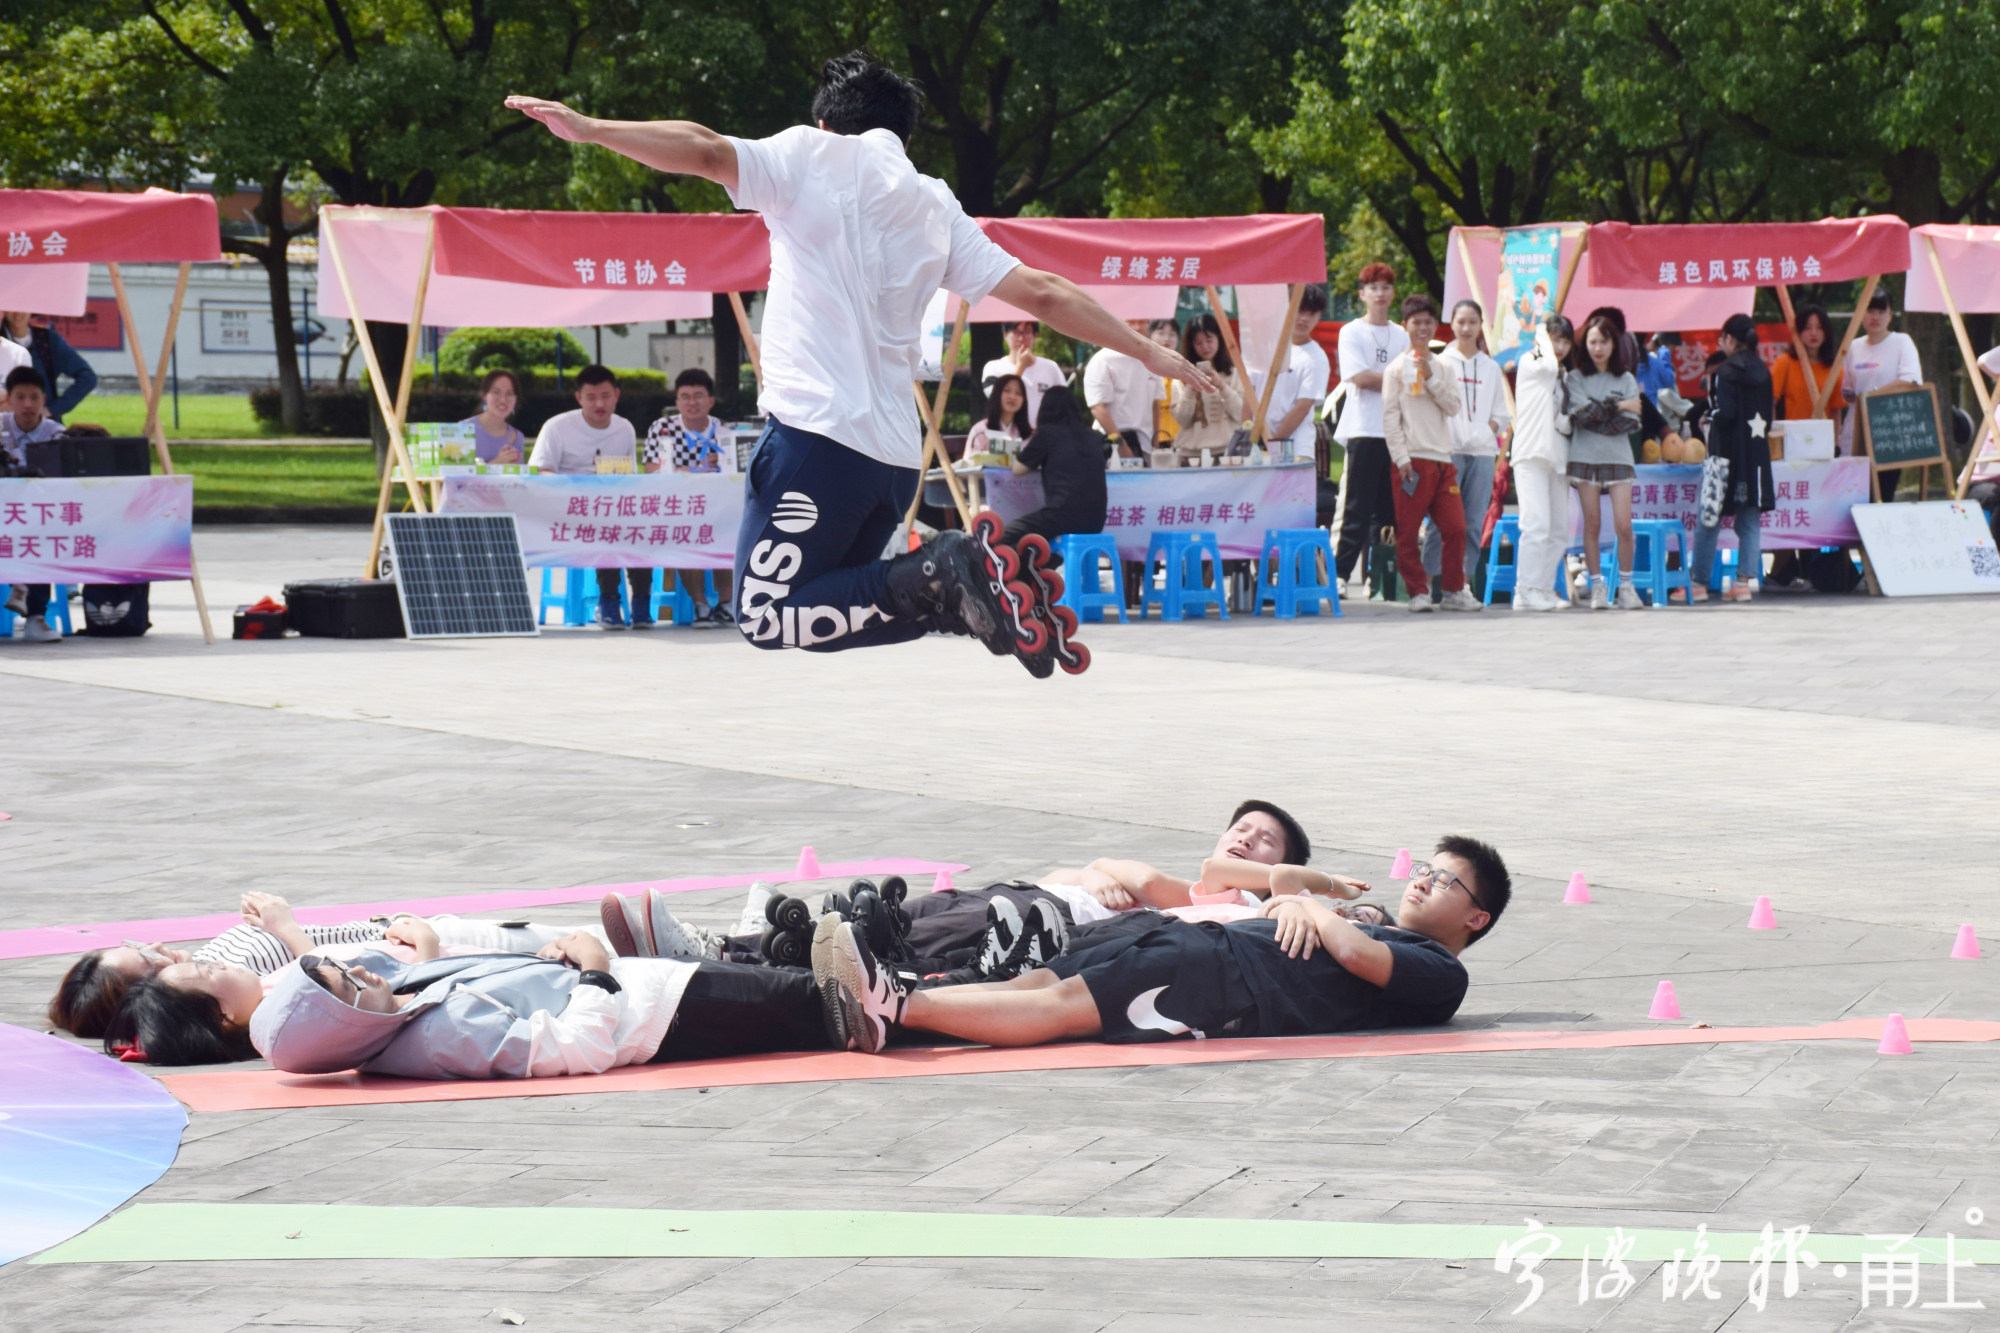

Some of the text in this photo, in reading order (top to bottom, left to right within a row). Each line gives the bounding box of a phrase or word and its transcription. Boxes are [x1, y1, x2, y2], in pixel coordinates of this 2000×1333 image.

[7, 231, 68, 257] 协会
[573, 258, 688, 286] 节能协会
[1101, 256, 1201, 280] 绿缘茶居
[1658, 255, 1822, 284] 绿色风环保协会
[3, 501, 84, 526] 天下事
[566, 494, 708, 517] 践行低碳生活
[1156, 502, 1256, 526] 相知寻年华
[550, 522, 716, 545] 让地球不再叹息
